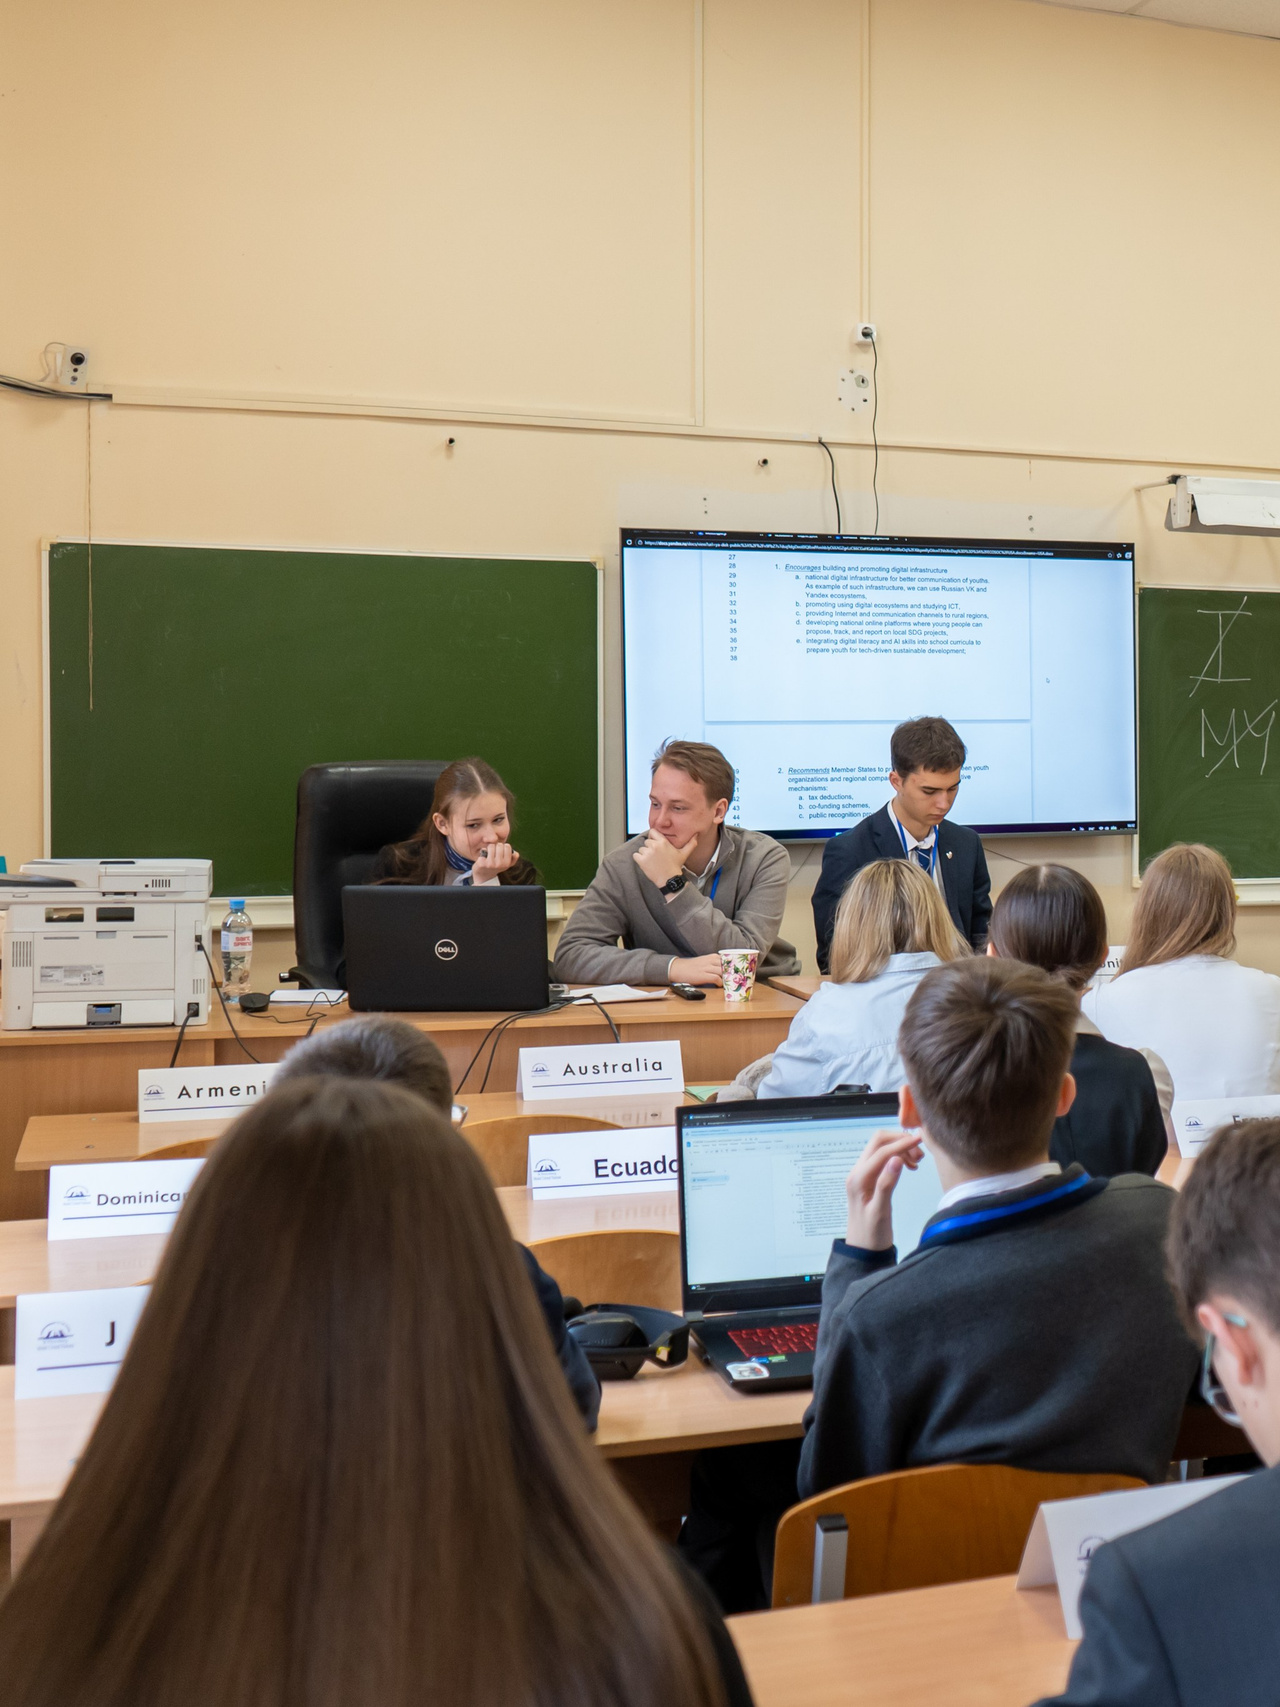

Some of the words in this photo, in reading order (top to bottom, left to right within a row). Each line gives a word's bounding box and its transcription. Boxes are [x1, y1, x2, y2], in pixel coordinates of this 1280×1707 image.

[785, 563, 821, 572] Encourages
[823, 564, 846, 572] building
[860, 565, 890, 574] promoting
[891, 565, 909, 574] digital
[831, 574, 848, 583] digital
[815, 583, 841, 591] example
[806, 601, 836, 609] promoting
[837, 601, 854, 610] using
[855, 602, 873, 610] digital
[874, 602, 909, 610] ecosystems
[923, 603, 947, 611] studying
[806, 610, 834, 618] providing
[806, 619, 839, 628] developing
[884, 620, 912, 628] platforms
[951, 621, 971, 629] people
[865, 629, 883, 637] report
[806, 638, 838, 646] integrating
[839, 638, 857, 646] digital
[858, 638, 880, 646] literacy
[831, 647, 848, 655] youth
[788, 776, 829, 785] organizations
[843, 775, 867, 784] regional
[809, 803, 841, 811] co-funding
[809, 812, 827, 820] public
[828, 811, 861, 820] recognition
[563, 1058, 663, 1076] Australia
[177, 1081, 267, 1099] Armeni
[594, 1155, 679, 1178] Ecuado
